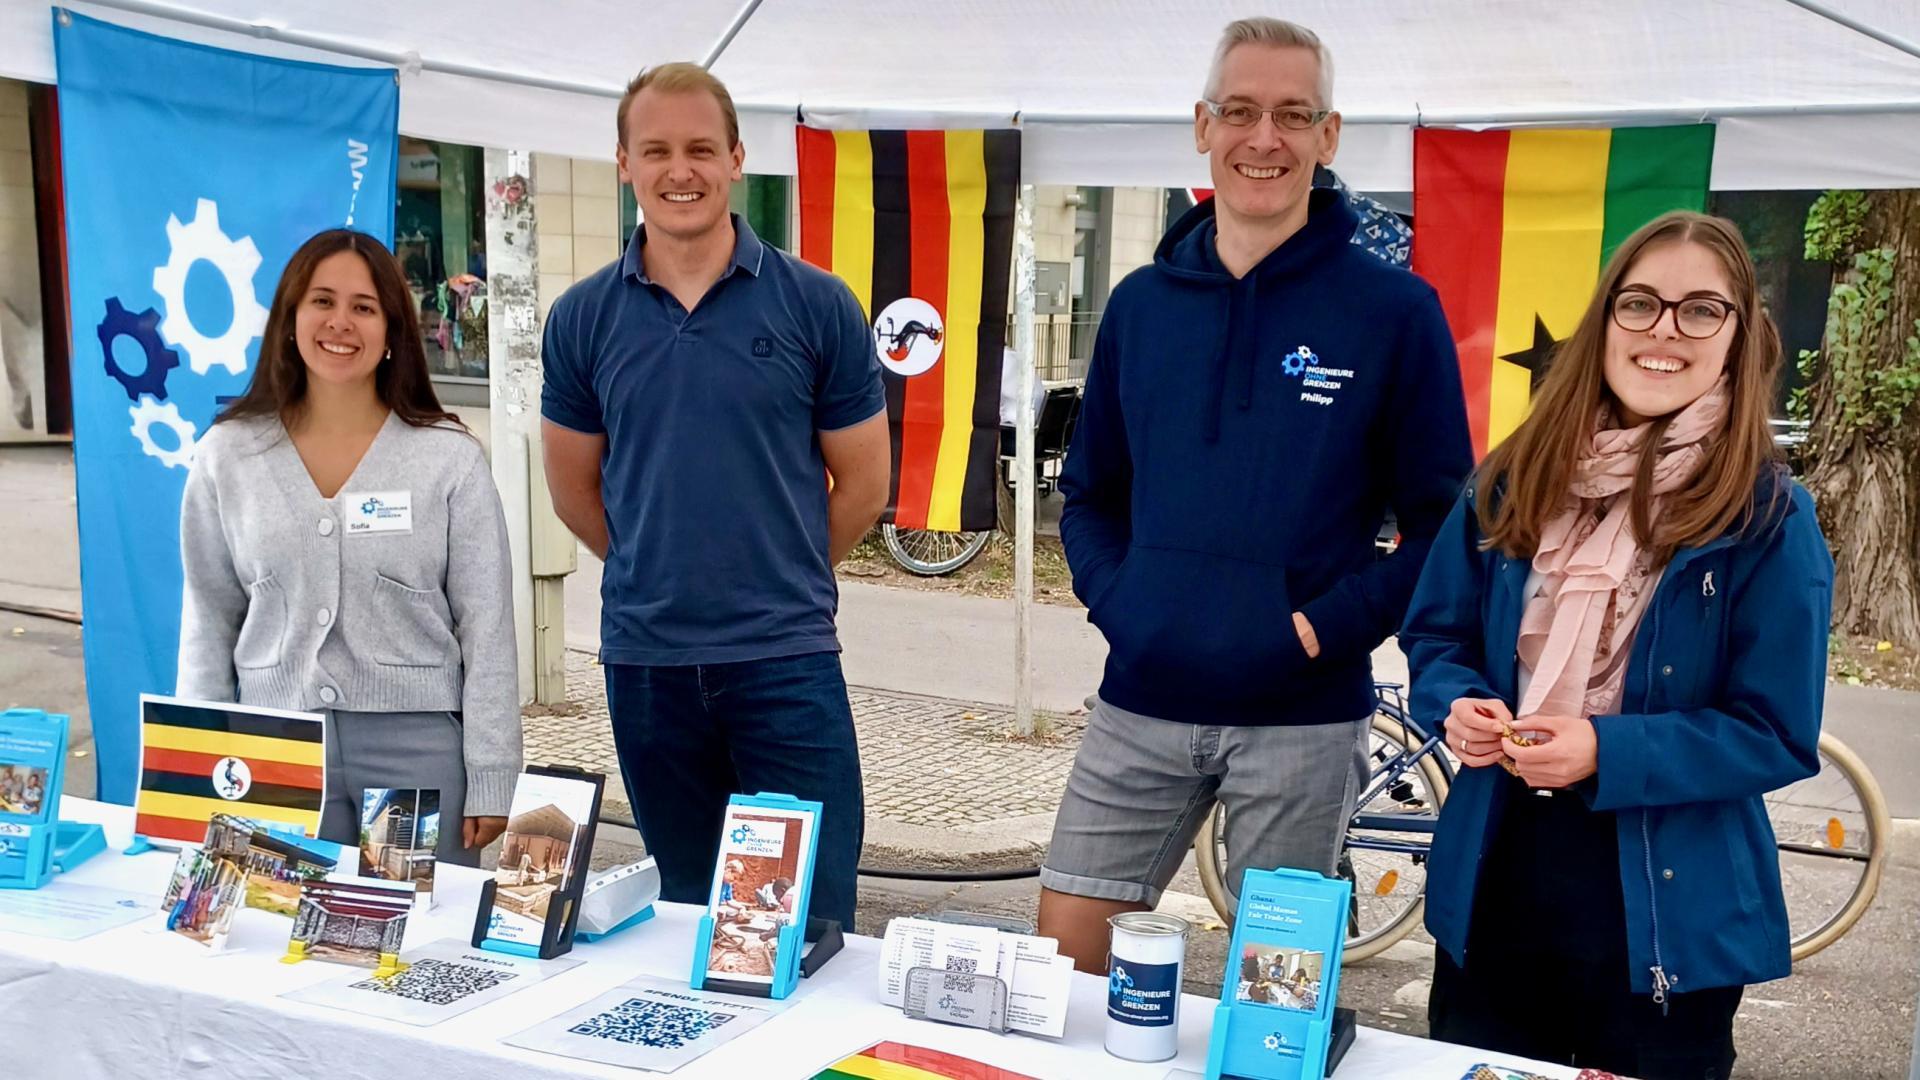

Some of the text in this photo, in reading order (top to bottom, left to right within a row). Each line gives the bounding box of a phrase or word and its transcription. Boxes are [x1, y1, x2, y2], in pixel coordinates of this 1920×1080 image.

[1304, 373, 1327, 382] OHNE
[1306, 366, 1354, 378] INGENIEURE
[1303, 379, 1341, 389] GRENZEN
[1300, 393, 1334, 405] Philipp
[462, 954, 515, 967] UGANDA
[643, 989, 702, 1002] SPENDE
[1122, 987, 1172, 999] INGENIEURE
[1122, 994, 1145, 1004] OHNE
[1121, 1000, 1161, 1011] GRENZEN
